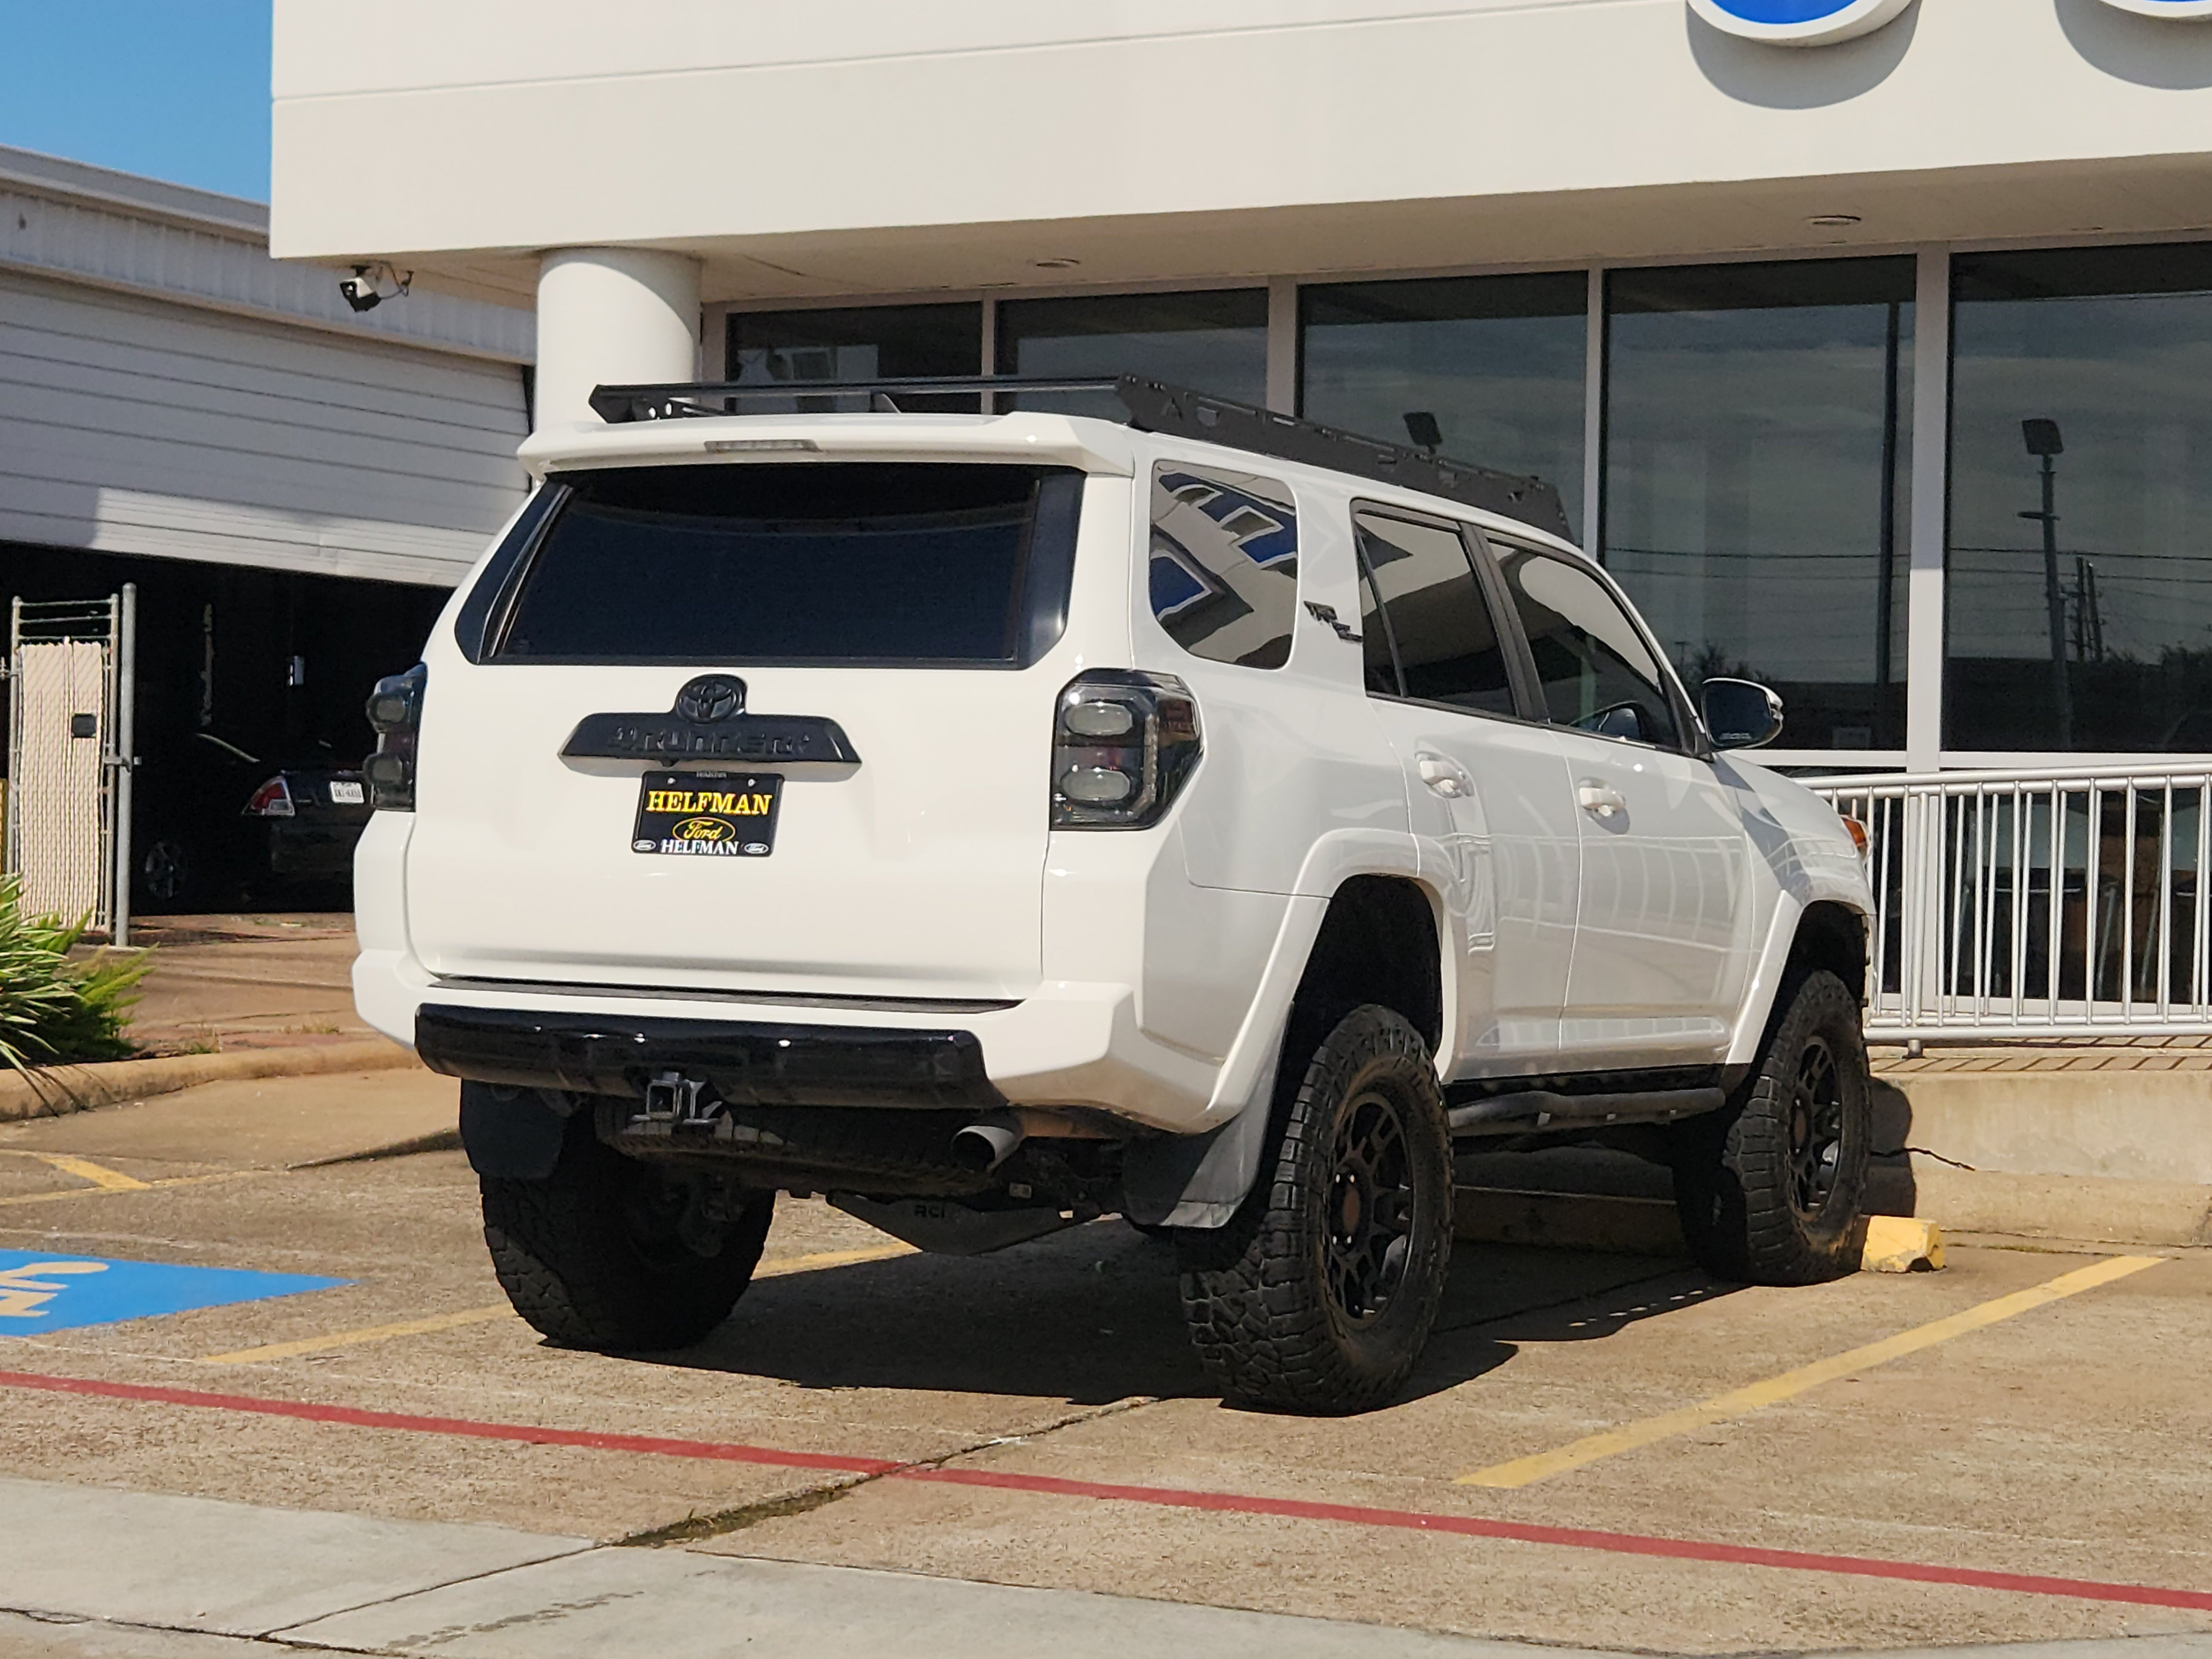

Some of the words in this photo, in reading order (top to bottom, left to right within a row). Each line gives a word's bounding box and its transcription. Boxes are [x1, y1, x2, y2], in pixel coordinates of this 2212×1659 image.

[646, 790, 773, 815] HELFMAN
[683, 820, 723, 840] Ford
[661, 839, 739, 855] HELFMAN
